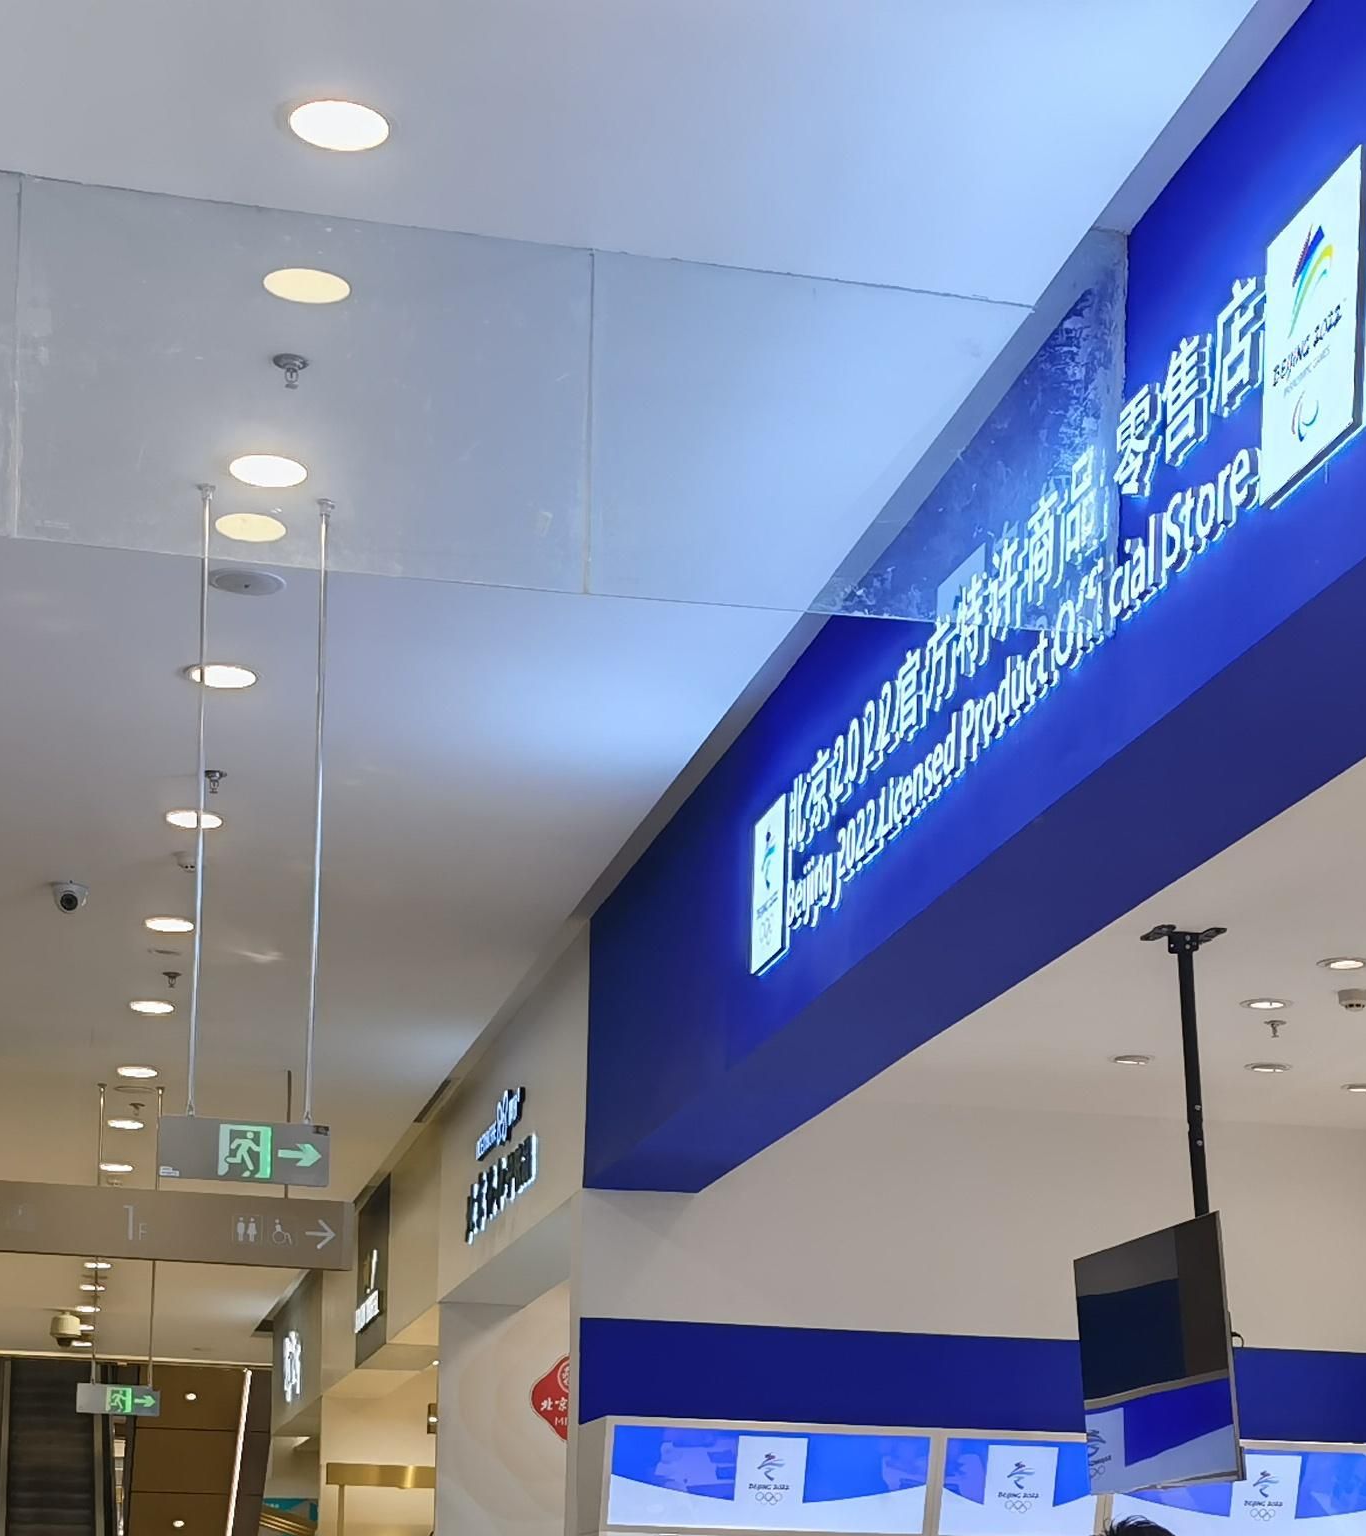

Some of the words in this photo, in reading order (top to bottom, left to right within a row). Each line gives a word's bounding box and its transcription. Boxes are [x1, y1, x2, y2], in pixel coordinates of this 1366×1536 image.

[787, 853, 836, 928] Beijing
[837, 799, 880, 880] 2022
[877, 711, 962, 842] Licensed
[960, 630, 1053, 762] Product
[1055, 512, 1161, 668] Official
[1165, 446, 1253, 572] Store
